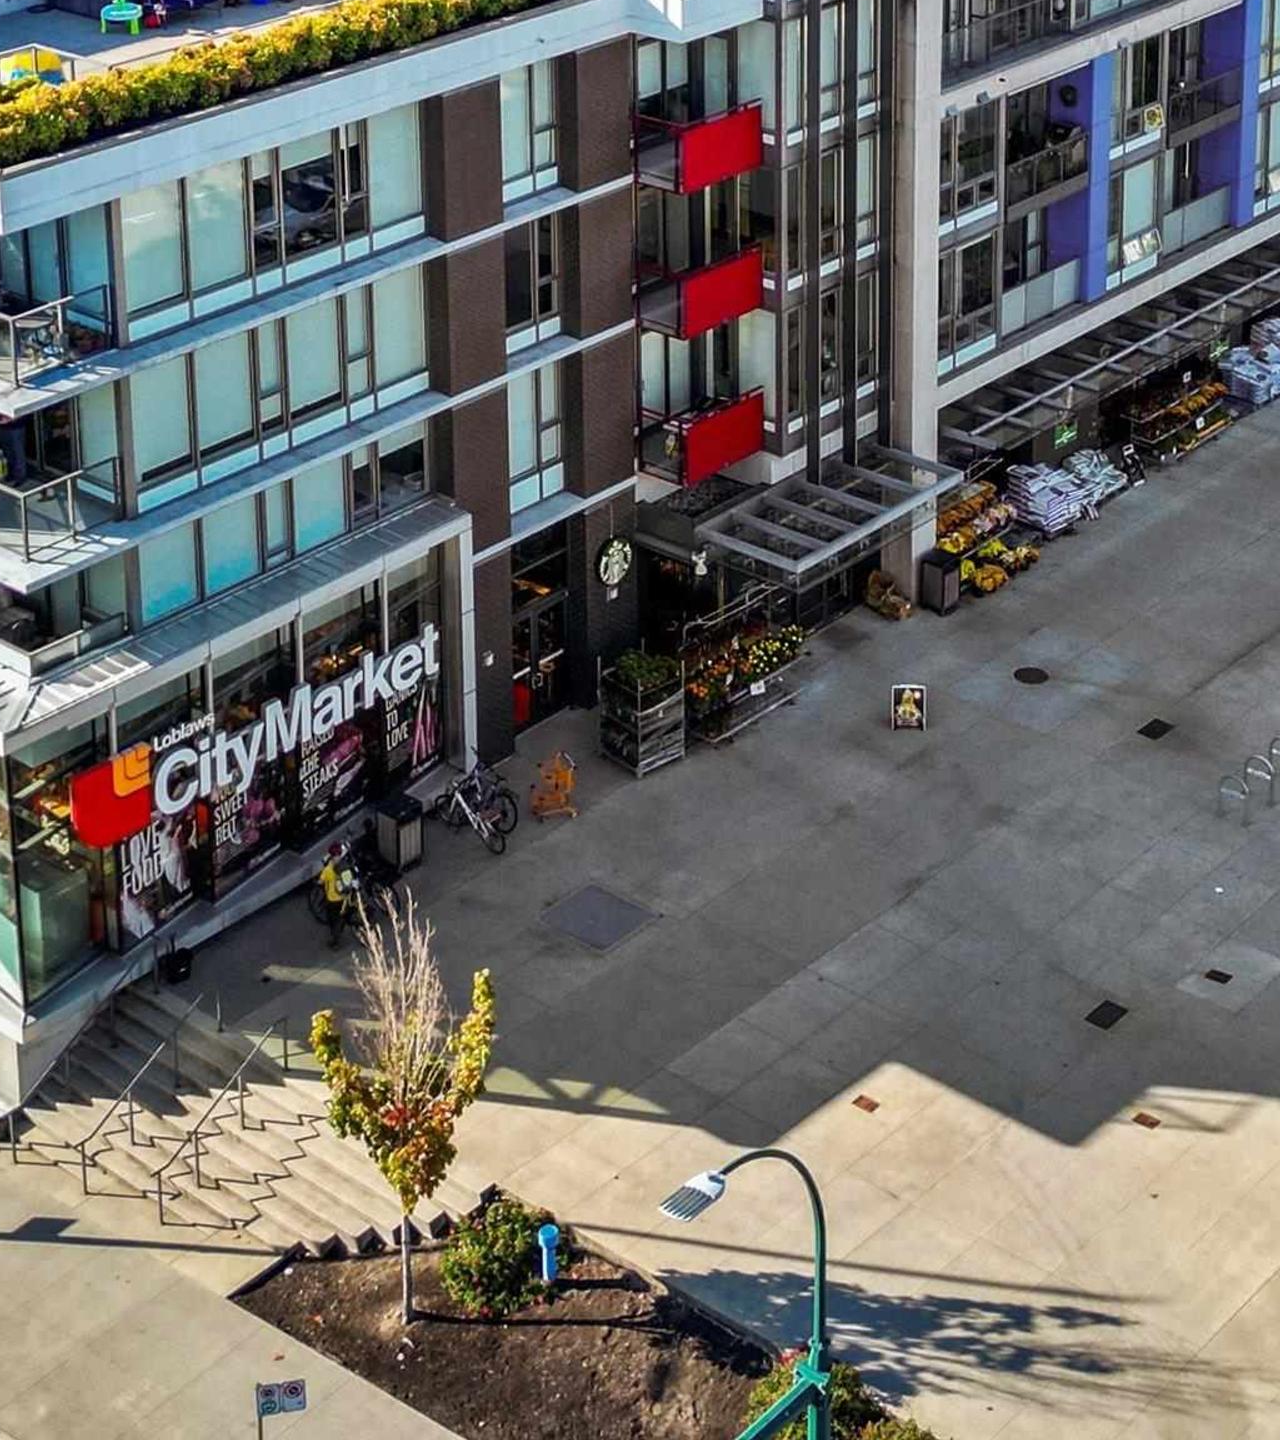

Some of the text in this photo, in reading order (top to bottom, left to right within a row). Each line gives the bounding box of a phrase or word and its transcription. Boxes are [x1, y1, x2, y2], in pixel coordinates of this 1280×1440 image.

[153, 712, 215, 752] Loblaws
[154, 621, 441, 815] CityMarket
[386, 720, 409, 751] LOVE
[302, 758, 339, 798] STEAKS
[121, 819, 161, 872] LOVE
[123, 850, 165, 895] FOOD
